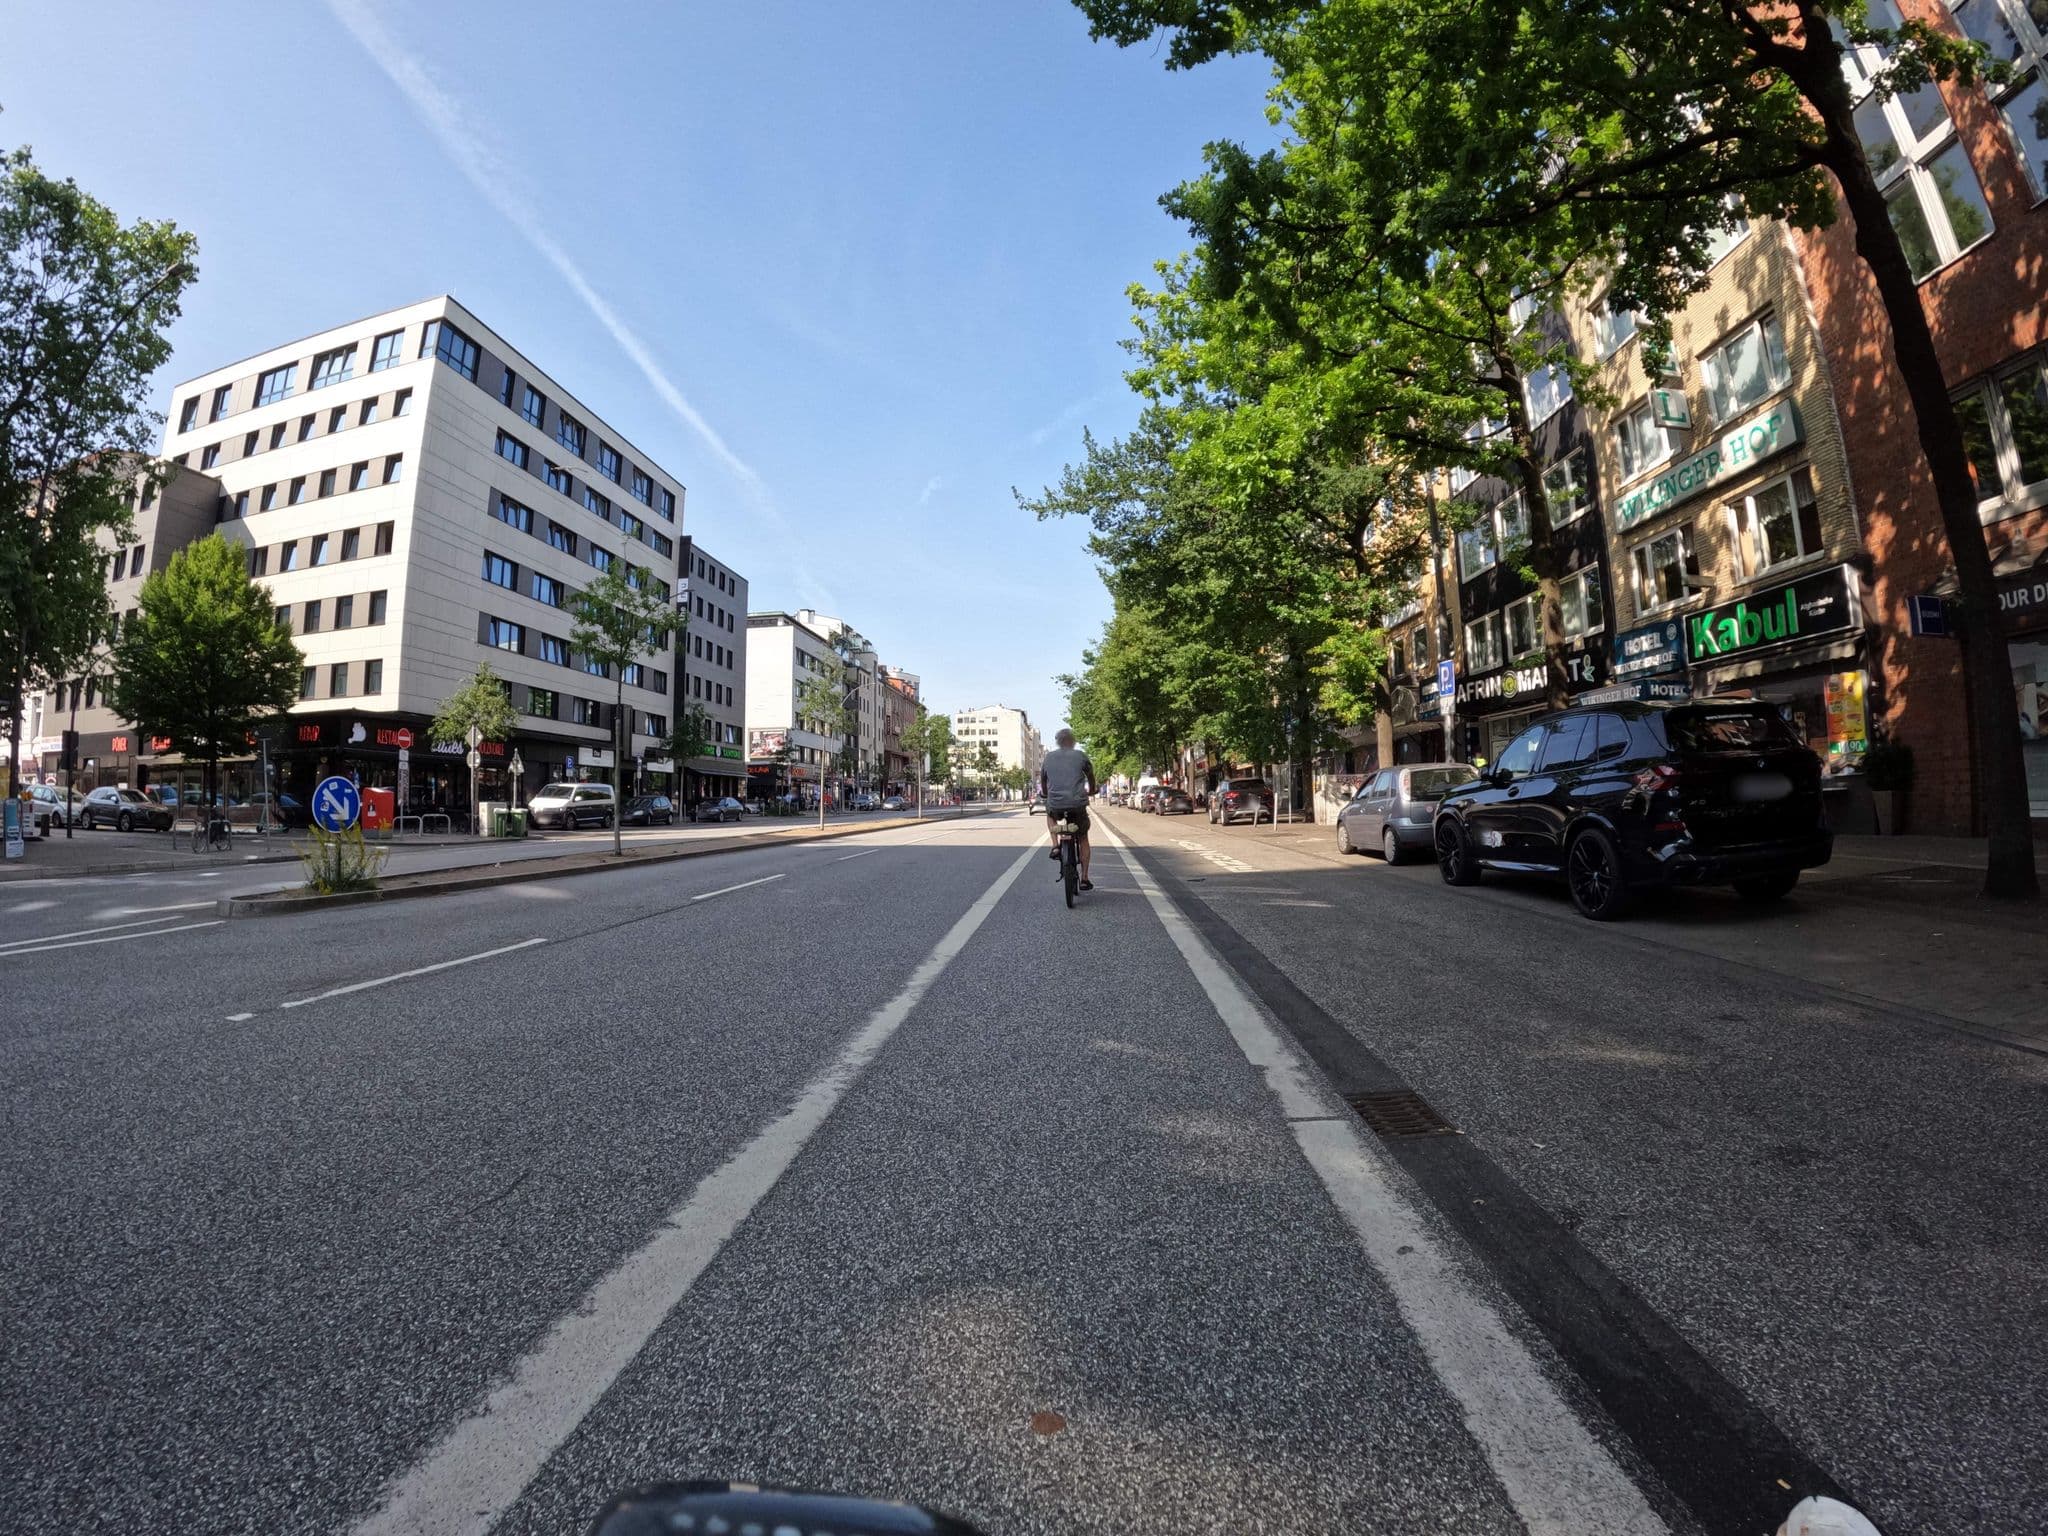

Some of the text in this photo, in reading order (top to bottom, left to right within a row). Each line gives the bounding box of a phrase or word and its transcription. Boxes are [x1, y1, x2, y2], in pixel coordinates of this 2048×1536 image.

[1619, 413, 1782, 522] WIKINGER HOF
[1624, 632, 1664, 656] HOTEL
[1691, 588, 1799, 658] Kabul
[1456, 675, 1503, 704] AFRIN
